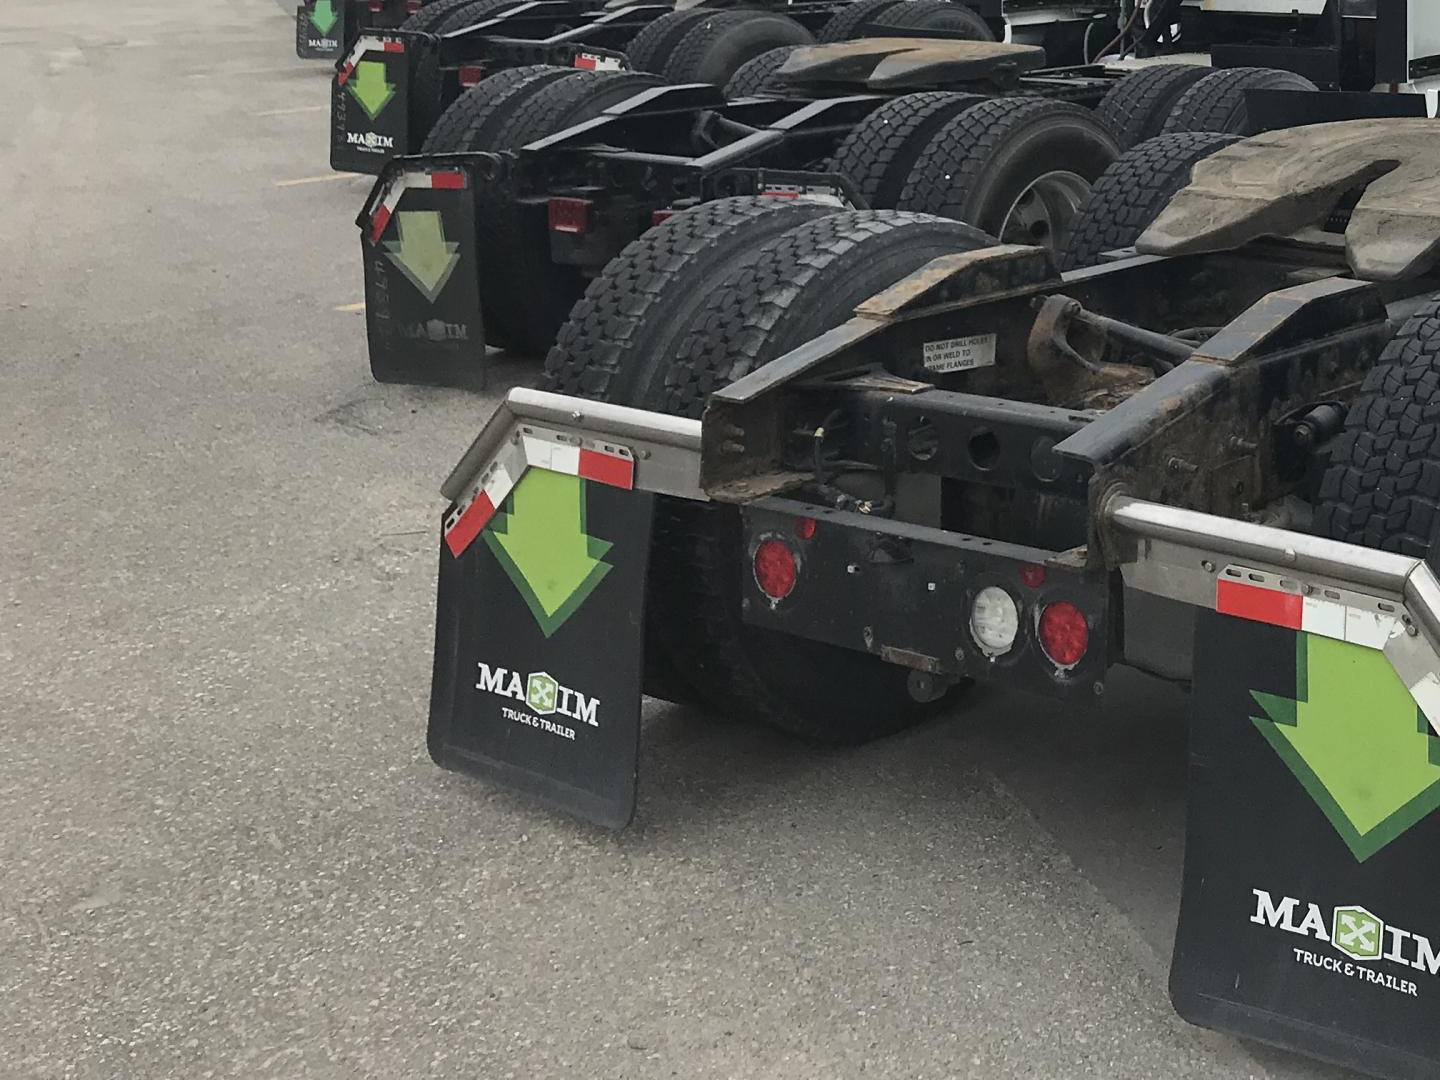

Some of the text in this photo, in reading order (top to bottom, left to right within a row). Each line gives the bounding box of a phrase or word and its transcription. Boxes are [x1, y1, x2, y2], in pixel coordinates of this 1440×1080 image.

[308, 38, 338, 49] MAIM
[925, 344, 934, 352] DO
[936, 342, 949, 351] NOT
[951, 339, 967, 348] DRILL
[943, 350, 961, 360] WELD
[946, 358, 974, 368] FLANGES
[475, 661, 601, 727] MAXIM
[501, 707, 576, 741] TRUCK & TRAILER
[1293, 947, 1418, 997] TRUCK & TRAILER
